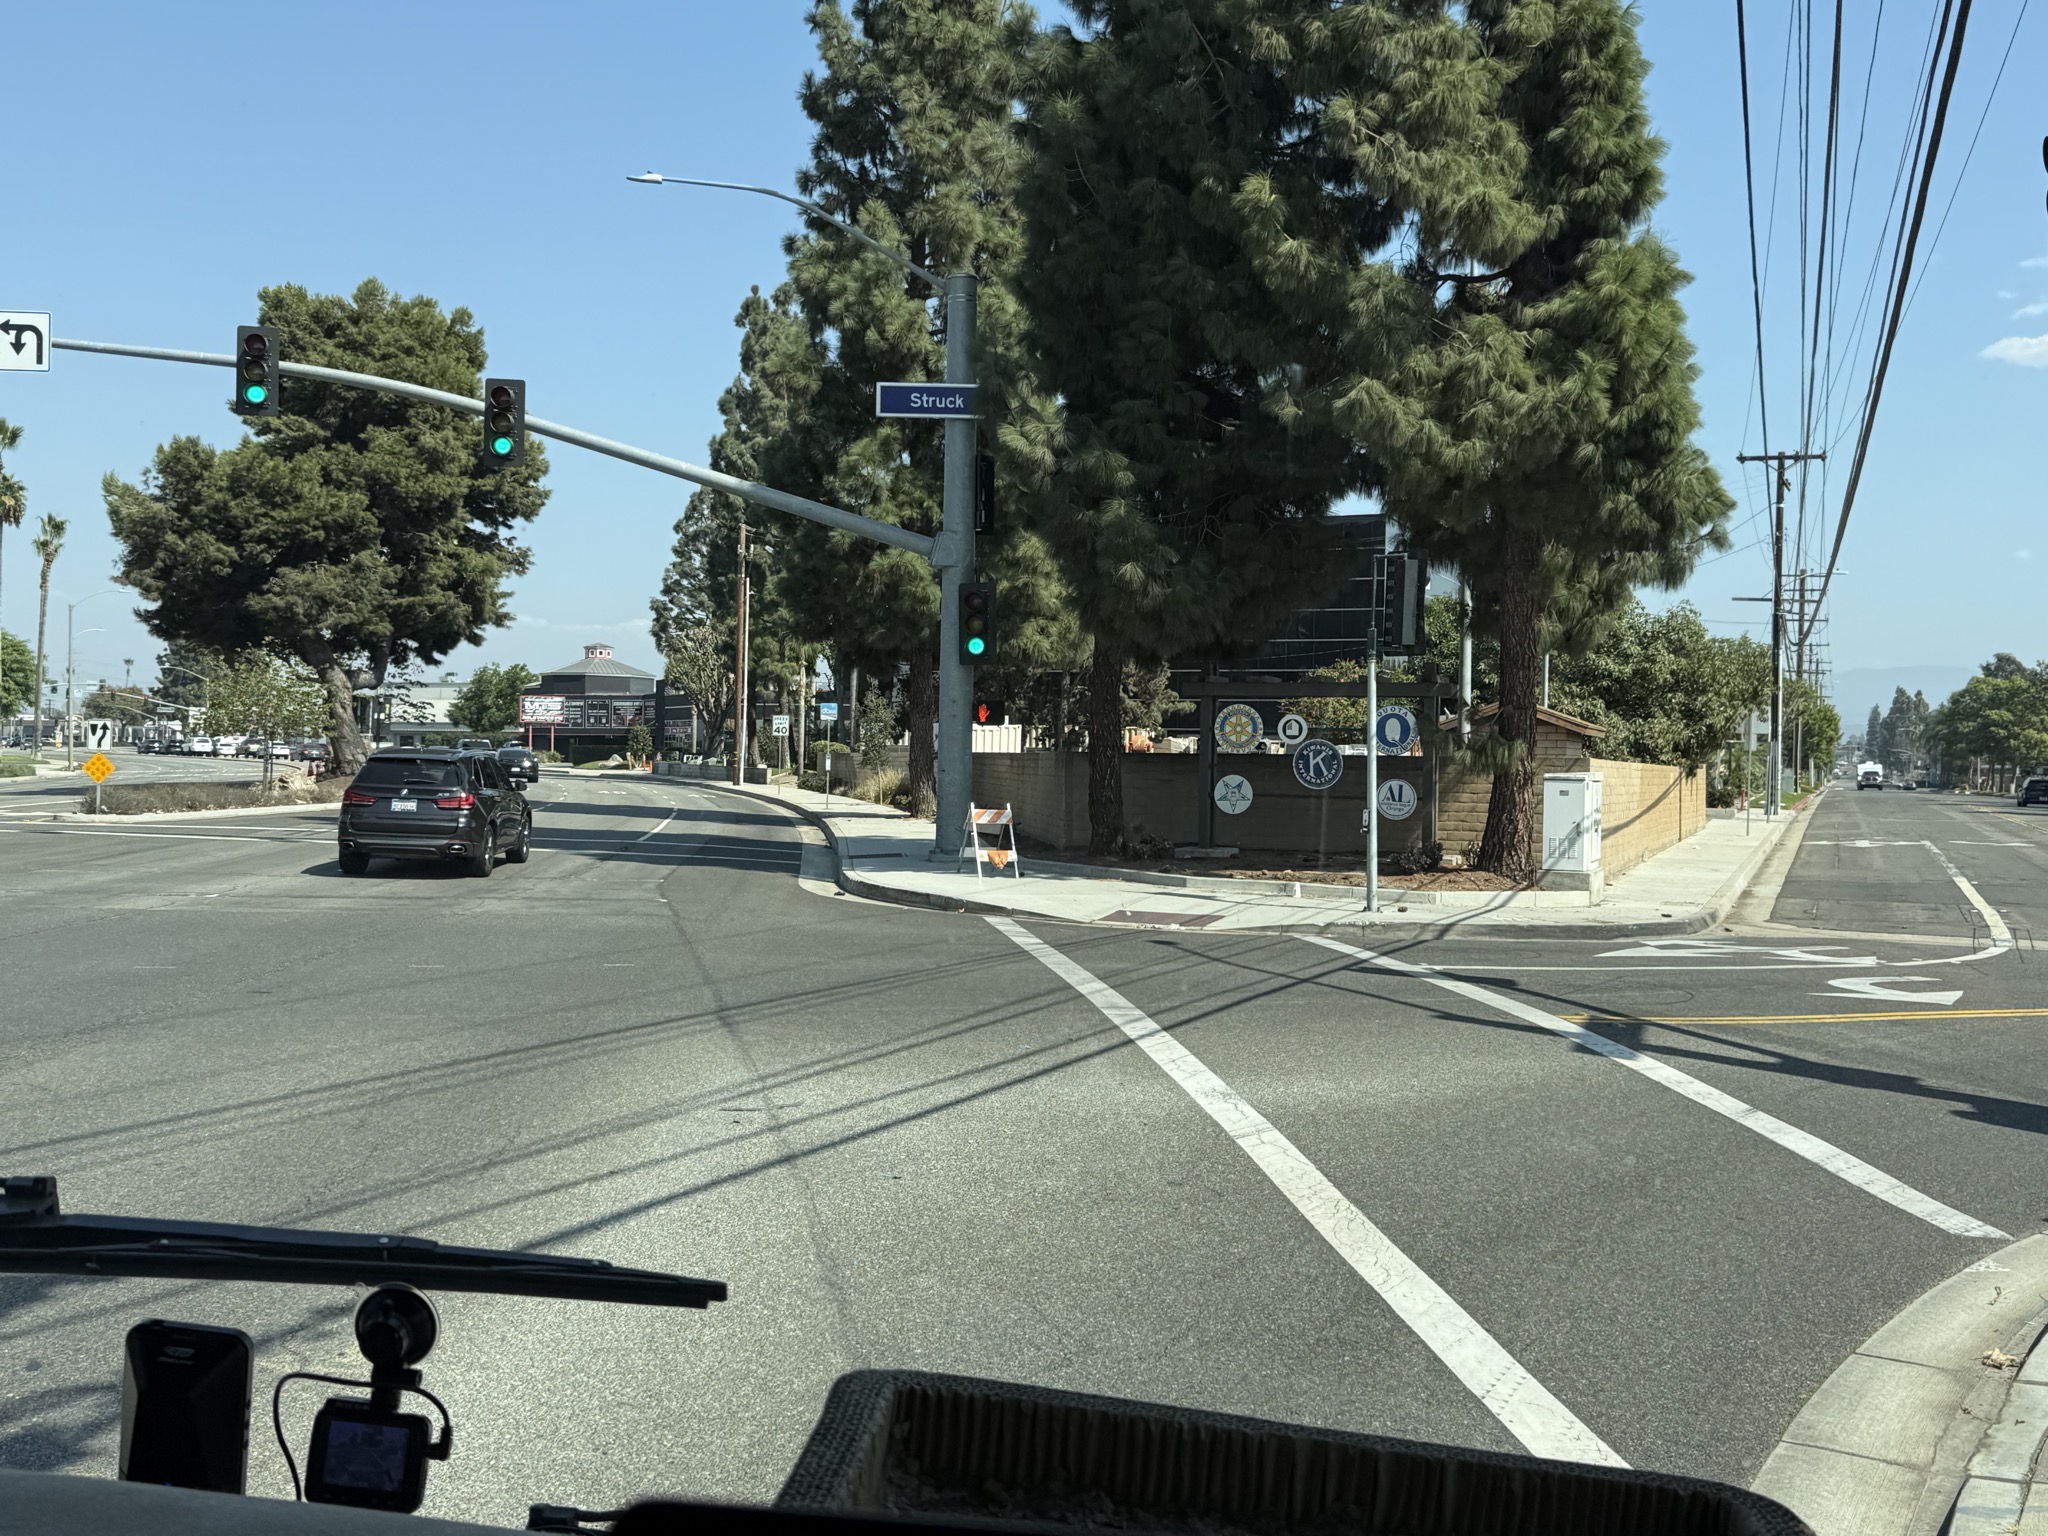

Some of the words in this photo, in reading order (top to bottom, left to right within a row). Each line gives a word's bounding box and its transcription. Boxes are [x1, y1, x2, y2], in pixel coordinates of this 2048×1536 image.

[910, 393, 964, 408] Struck
[1376, 706, 1408, 717] QUOTA
[774, 726, 788, 734] 40
[1376, 713, 1411, 751] Q
[1302, 744, 1334, 756] KIWANIS
[1298, 760, 1338, 784] INTERNATIONAL
[1308, 750, 1329, 779] K
[1381, 784, 1411, 803] AL
